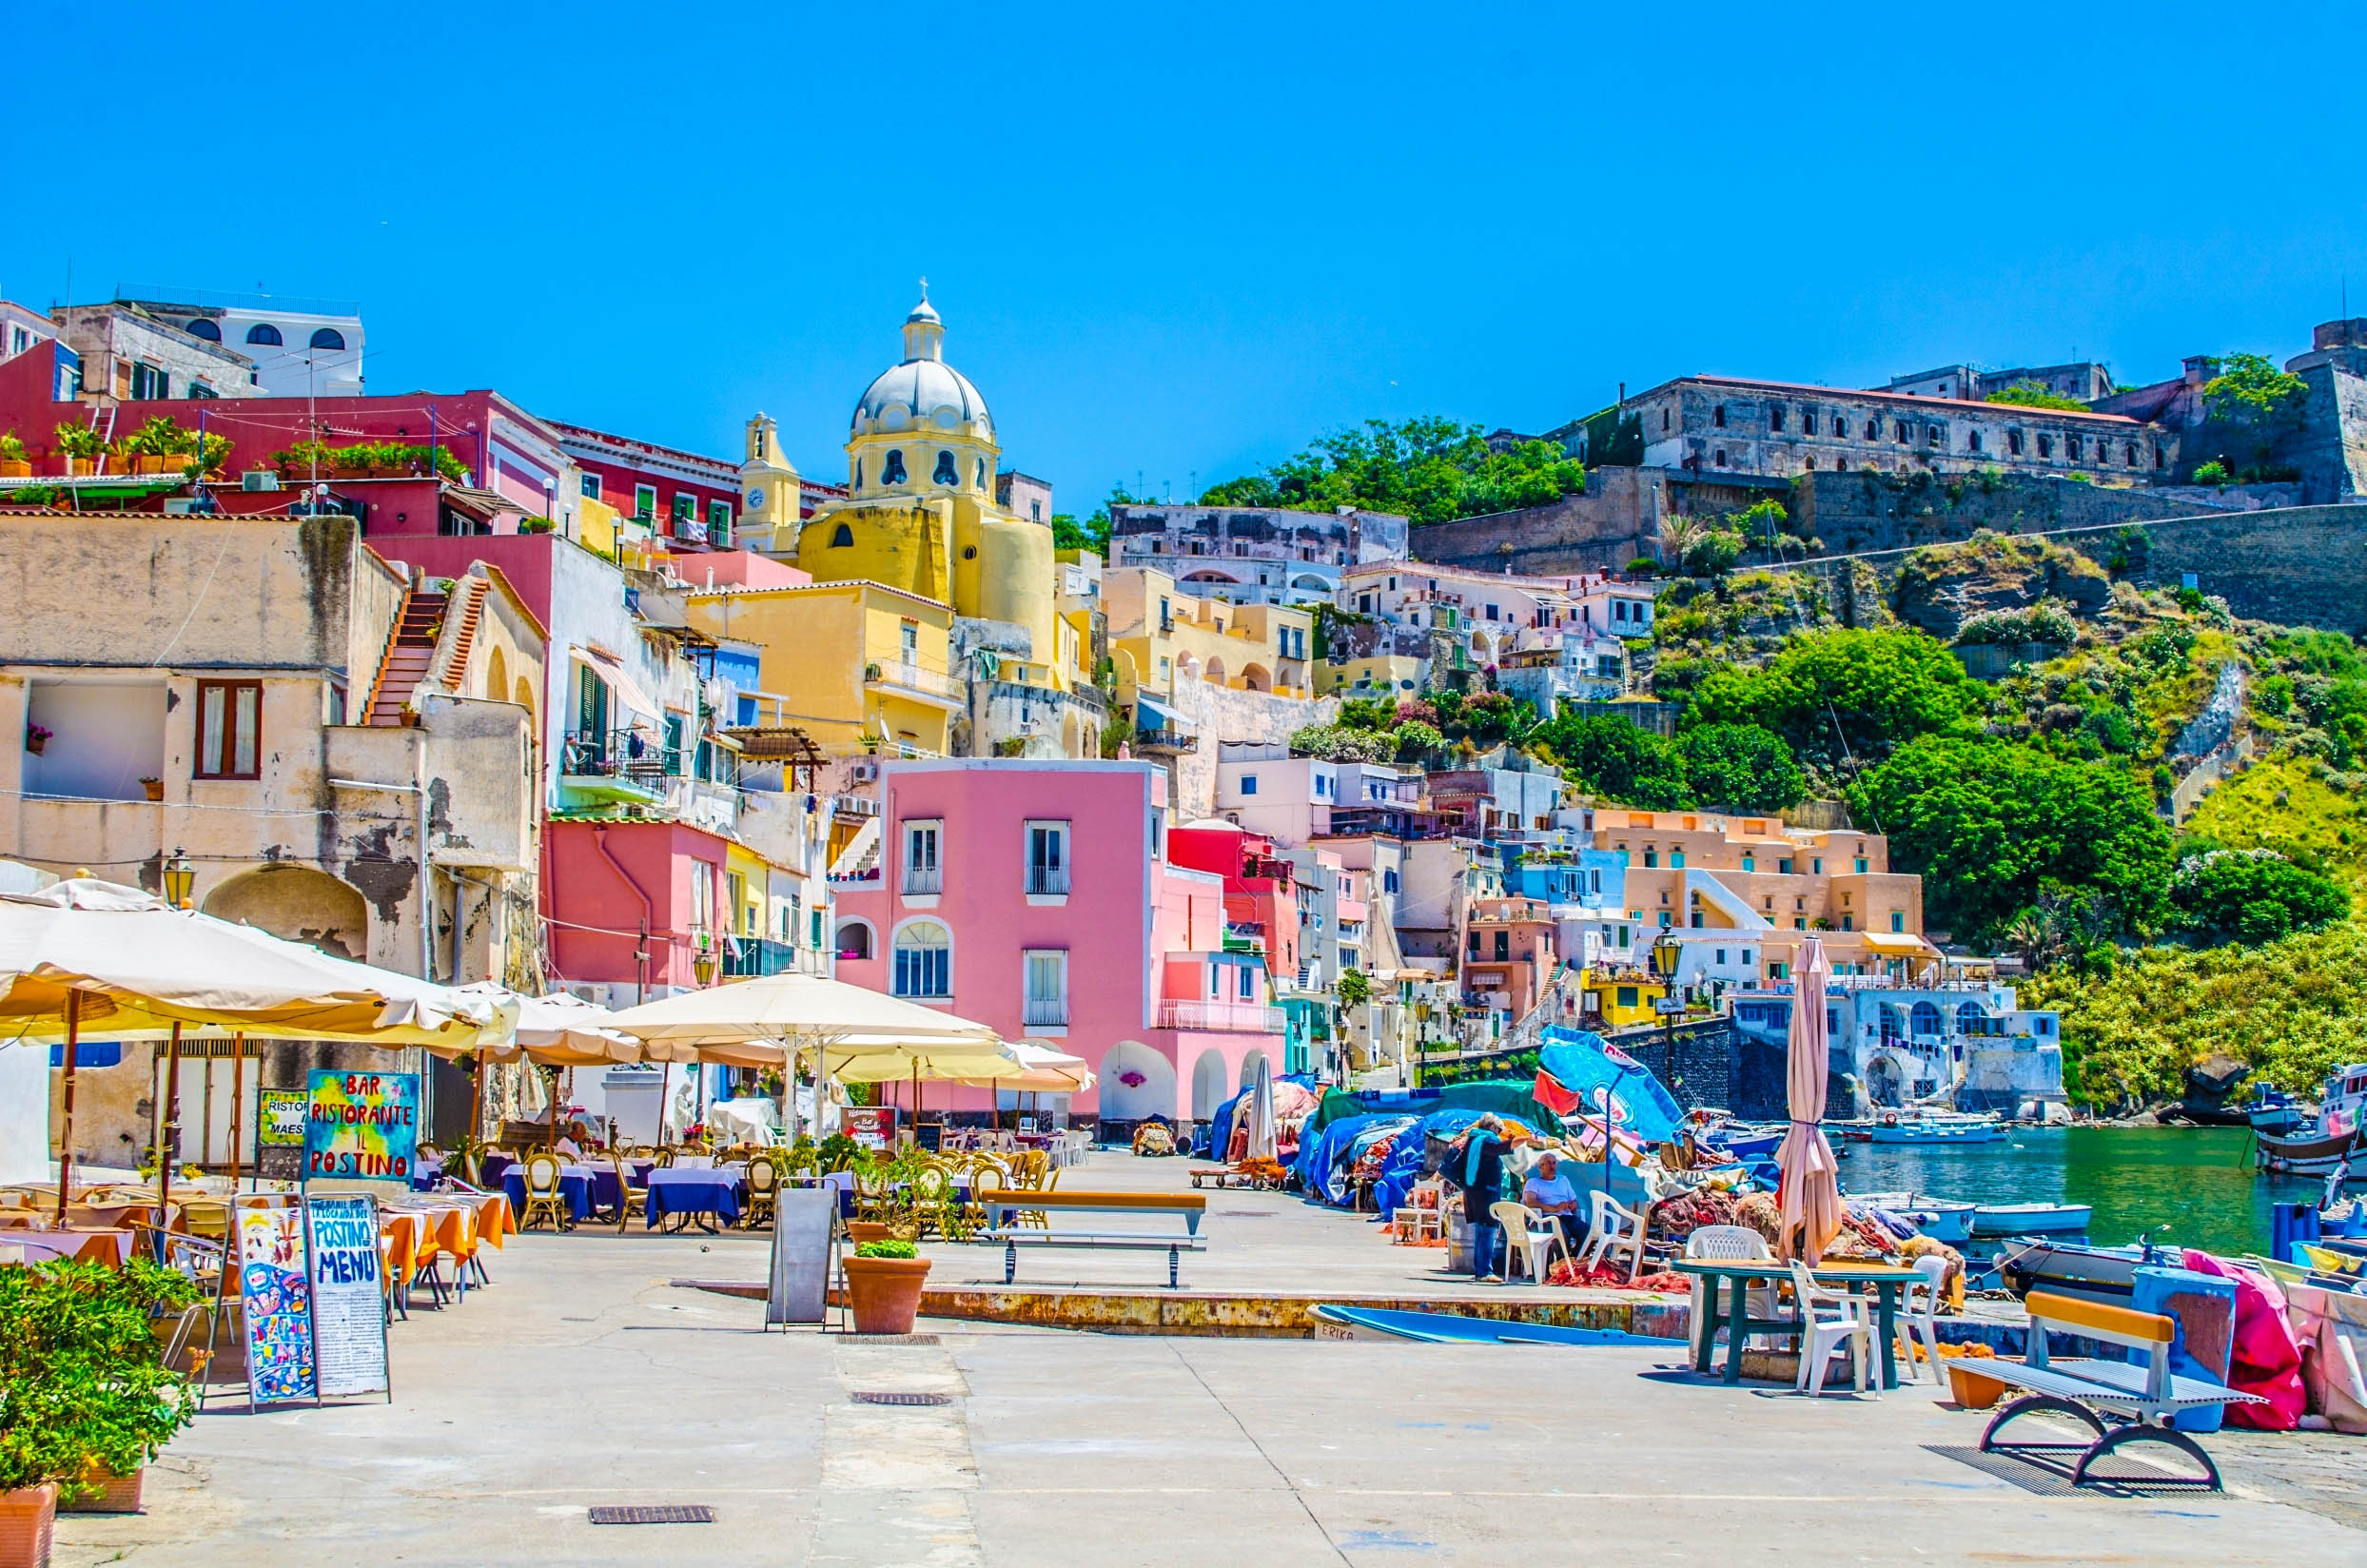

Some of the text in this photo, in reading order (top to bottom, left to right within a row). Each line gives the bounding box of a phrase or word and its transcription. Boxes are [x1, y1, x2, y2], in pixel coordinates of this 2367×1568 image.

[345, 1074, 381, 1095] BAR
[311, 1103, 412, 1126] RISTORANTE
[357, 1133, 366, 1149] IL
[310, 1150, 407, 1176] POSTINO
[314, 1220, 371, 1247] POSTINO
[319, 1250, 375, 1284] MENU
[1322, 1323, 1354, 1340] ERIKA
